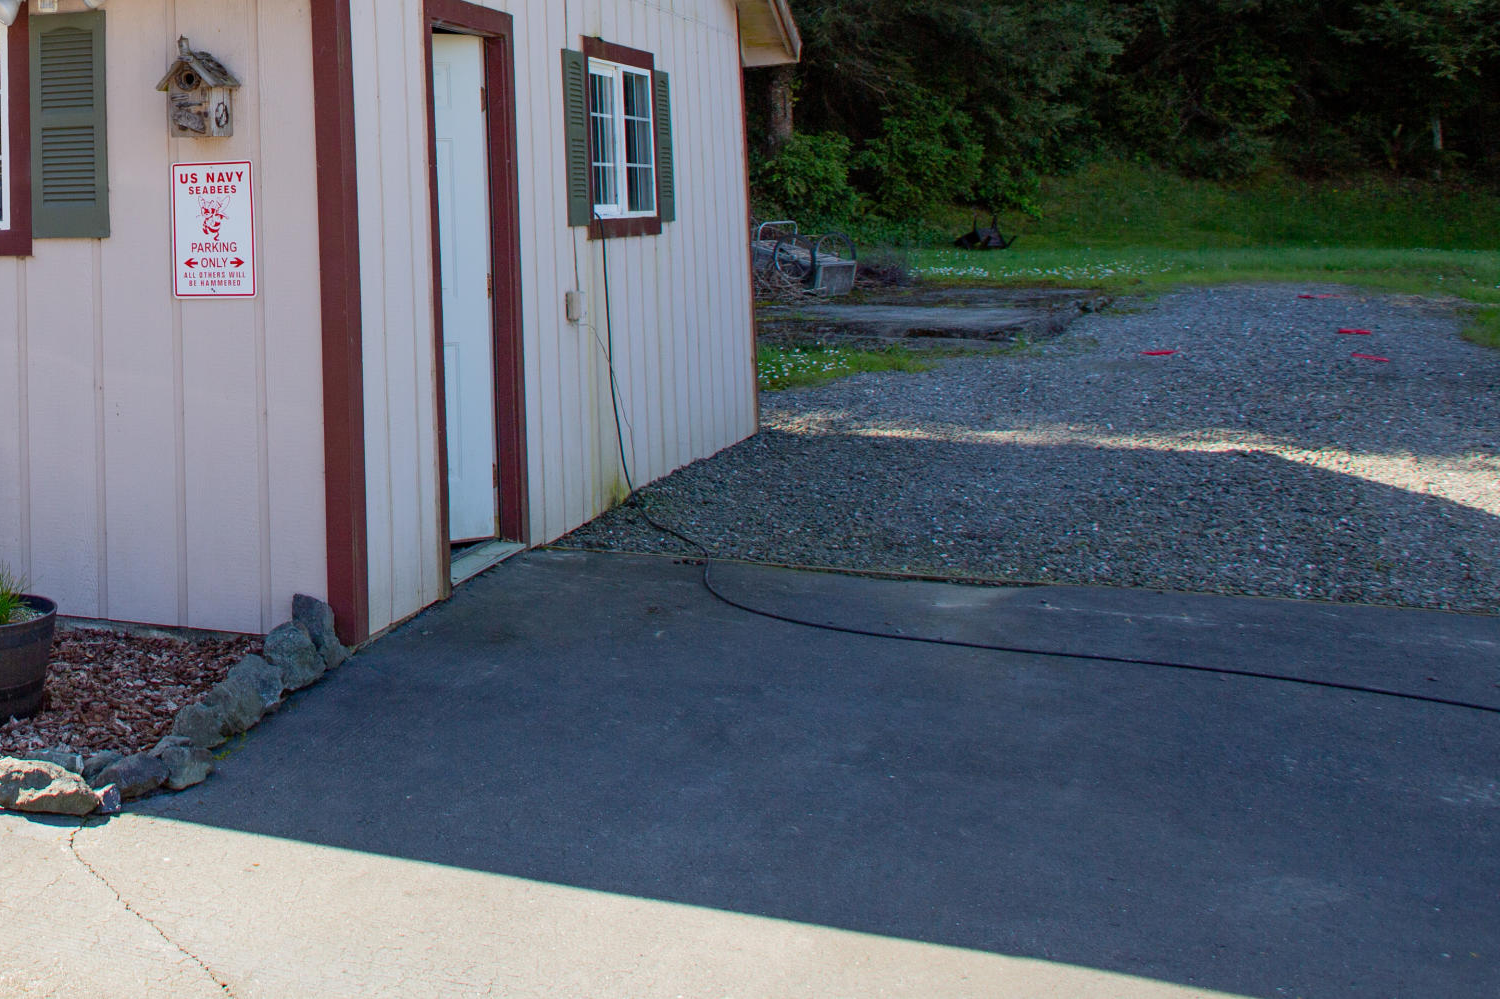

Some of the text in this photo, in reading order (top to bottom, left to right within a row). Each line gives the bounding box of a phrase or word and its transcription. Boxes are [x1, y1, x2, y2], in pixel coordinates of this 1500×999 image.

[180, 171, 244, 184] US NAVY
[188, 185, 237, 195] SEABEES
[191, 241, 237, 253] PARKING
[200, 257, 228, 268] ONLY
[184, 271, 246, 279] ALL OTHERS WILL
[188, 279, 241, 287] BE HAMMERED
